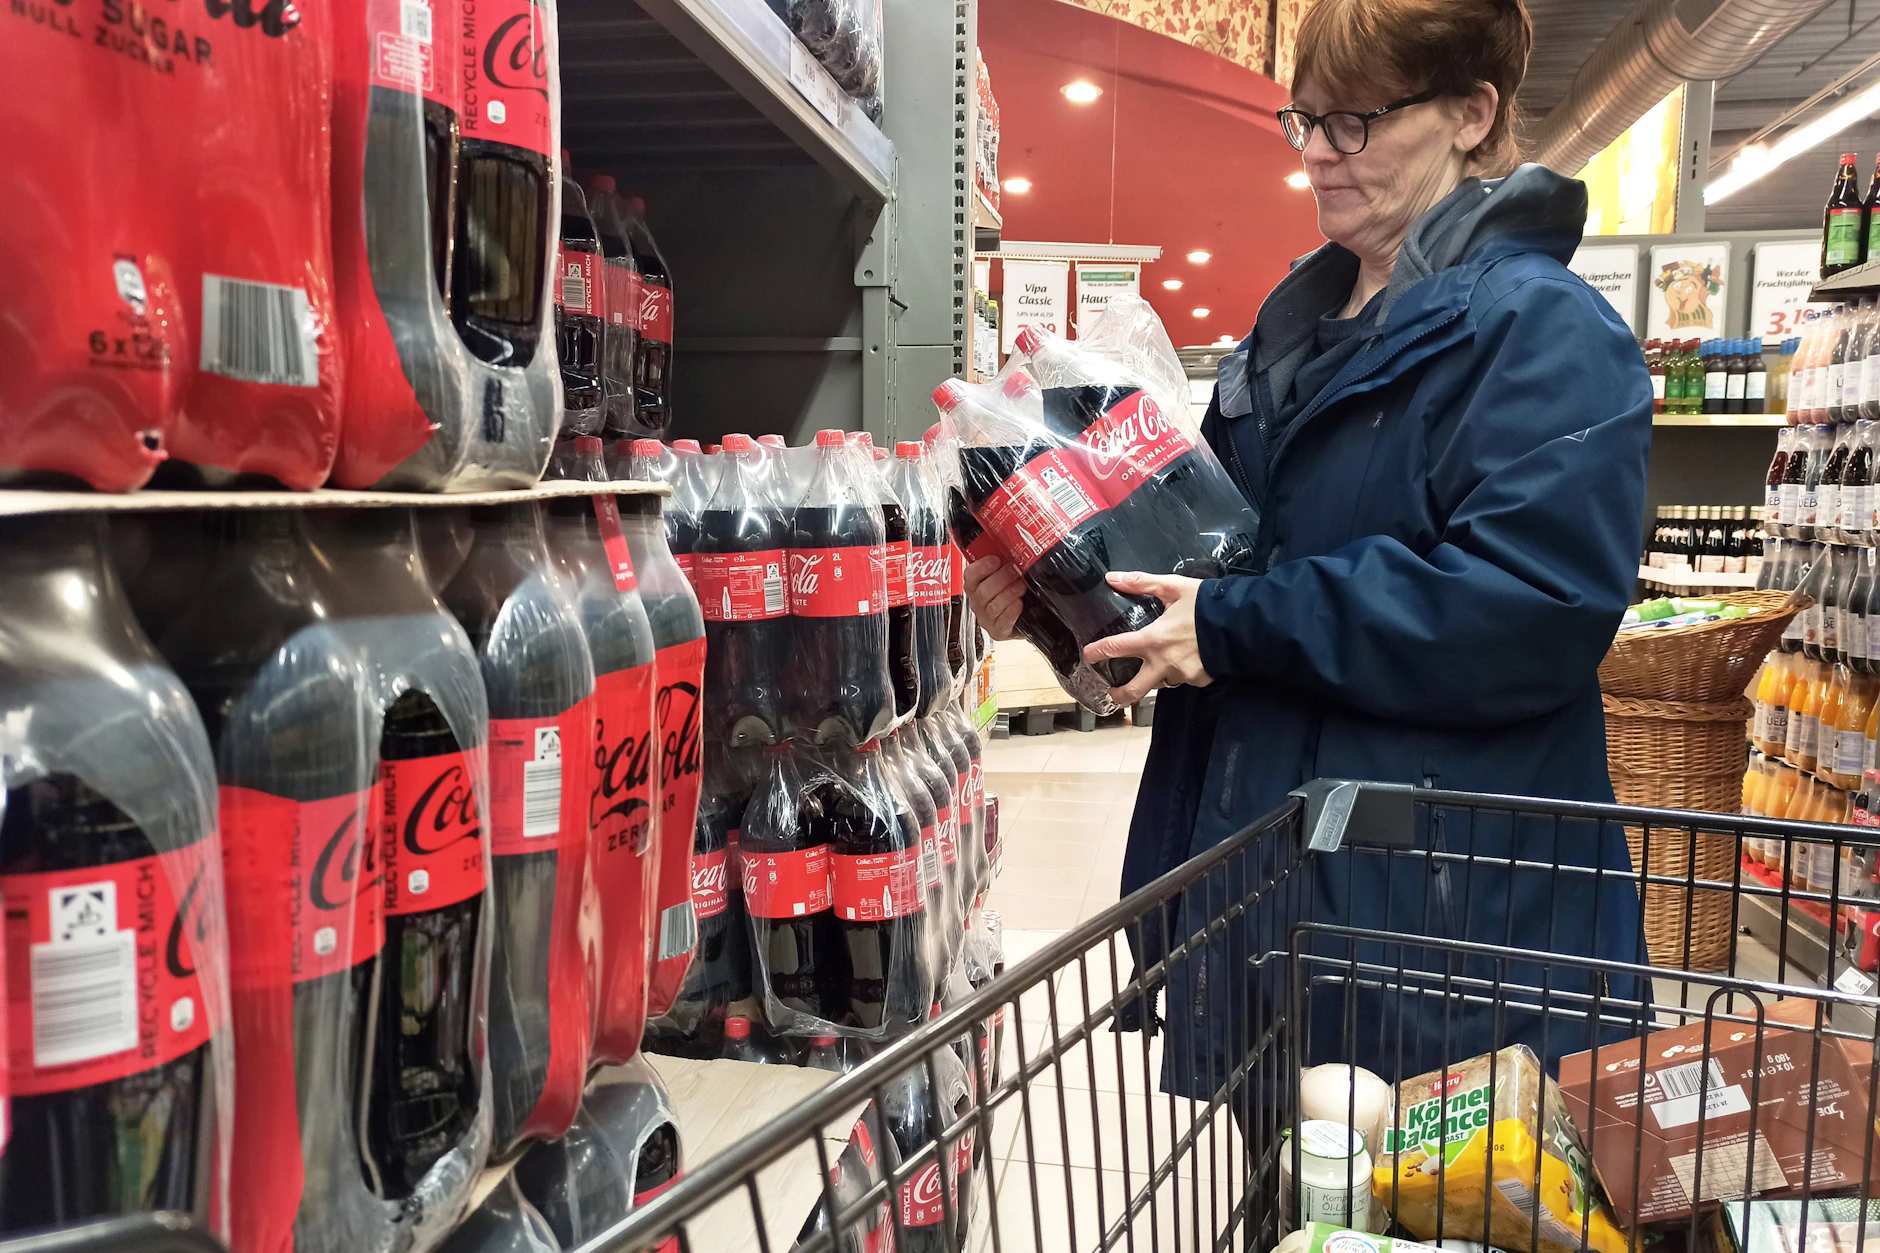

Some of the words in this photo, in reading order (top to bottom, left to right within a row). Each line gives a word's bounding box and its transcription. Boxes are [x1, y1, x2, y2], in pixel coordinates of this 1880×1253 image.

[462, 0, 476, 40] MIC
[102, 0, 213, 64] SUGAR
[463, 47, 478, 131] RECYCLE
[1776, 269, 1811, 277] Werder
[1024, 283, 1047, 295] Vipa
[1592, 283, 1622, 292] wein
[1018, 295, 1053, 306] Classic
[1081, 294, 1113, 304] Haus
[1086, 394, 1174, 480] Coca-Co
[1048, 451, 1069, 474] MICH
[1121, 445, 1167, 481] ORIGINAL
[1069, 473, 1099, 512] RECYCLE
[832, 553, 842, 561] 2L
[790, 554, 825, 595] ola
[782, 575, 790, 614] RECYCLE
[914, 589, 947, 598] ORIGINAL
[383, 763, 397, 817] MICH
[383, 820, 398, 910] RECYCLE
[767, 858, 776, 866] 2L
[694, 897, 724, 909] RIGINAL
[1774, 1052, 1791, 1063] 180
[1783, 1062, 1795, 1071] 10
[1433, 1076, 1460, 1091] Hrry
[1816, 1101, 1840, 1117] JDE
[1385, 1107, 1488, 1153] Balance
[1444, 1132, 1465, 1143] OAST
[903, 1187, 911, 1226] RECYCLE
